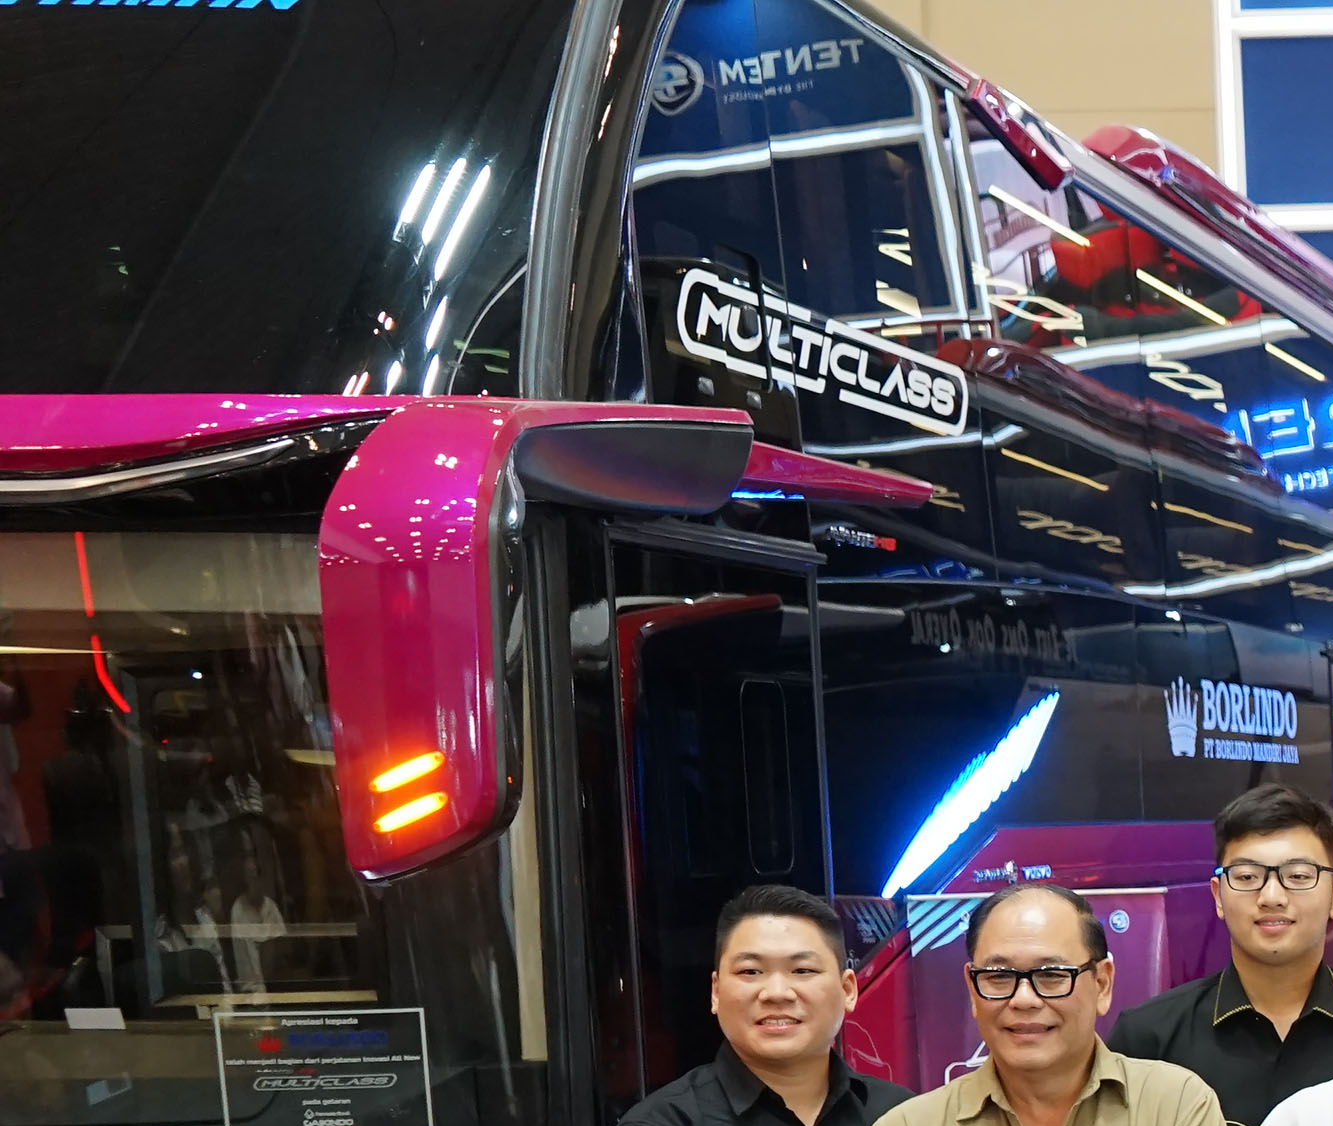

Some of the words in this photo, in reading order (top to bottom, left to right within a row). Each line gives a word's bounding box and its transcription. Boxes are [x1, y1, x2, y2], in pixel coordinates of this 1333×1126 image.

[696, 291, 957, 417] MULTICLASS
[1201, 679, 1298, 739] BORLINDO
[1204, 738, 1214, 758] PT
[261, 1075, 389, 1089] MULTICLASS
